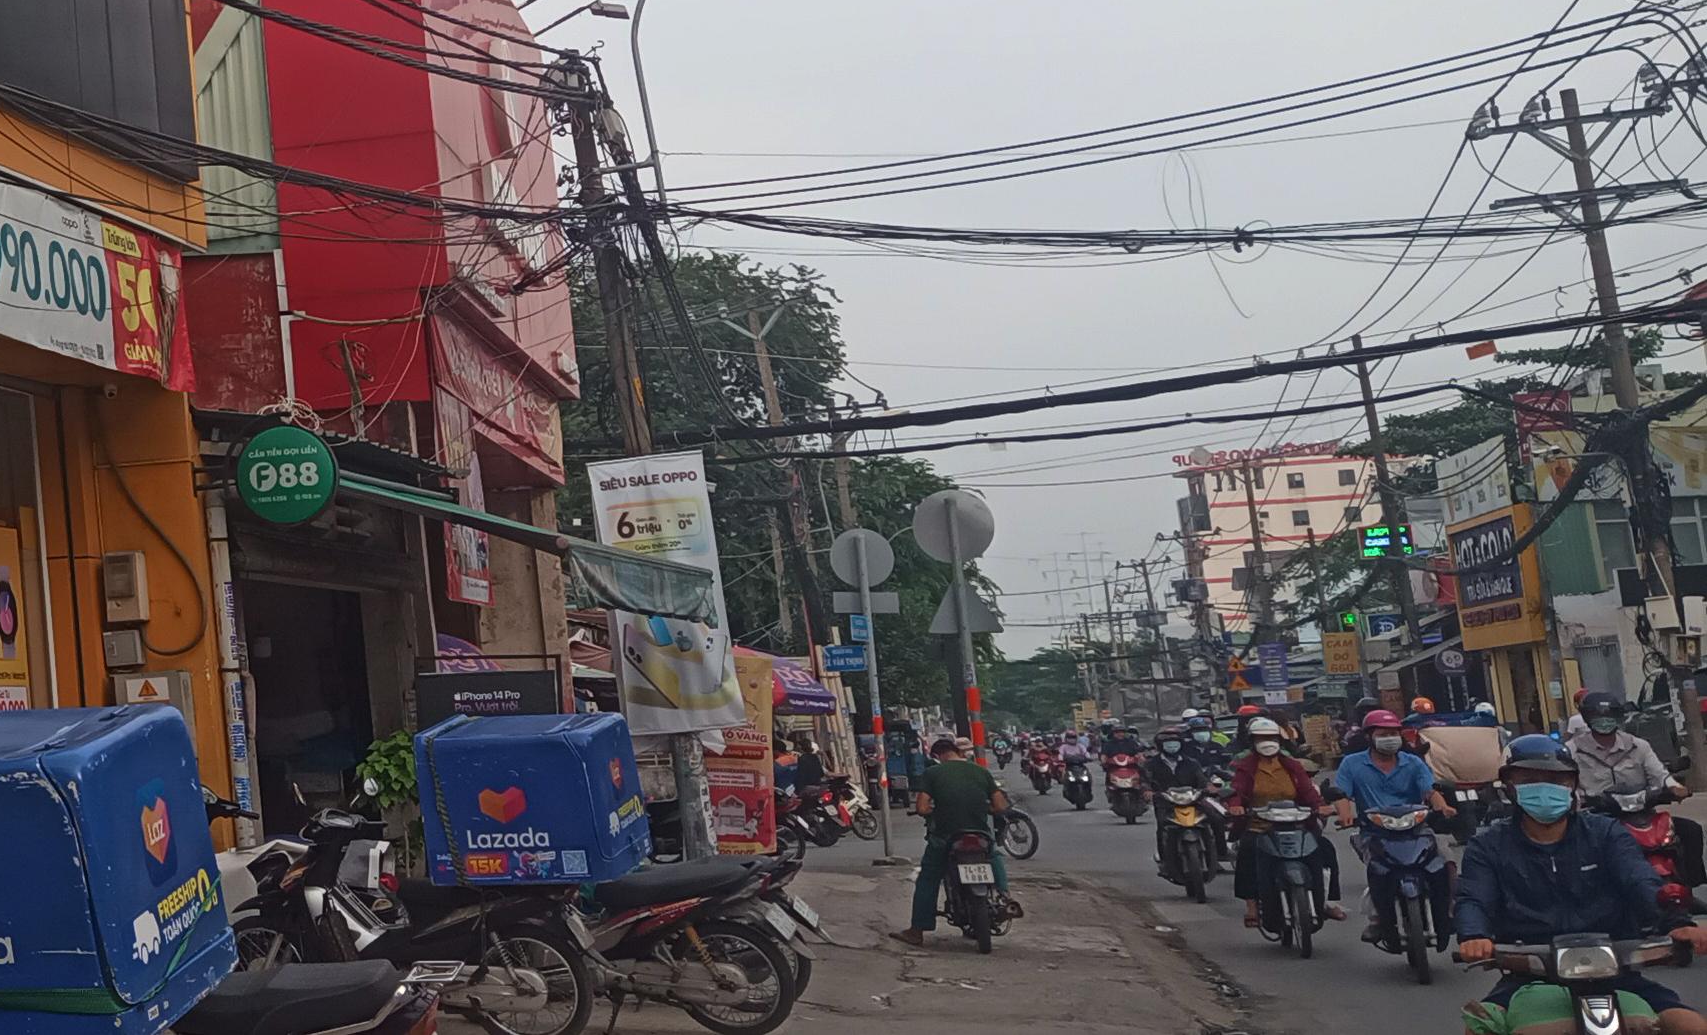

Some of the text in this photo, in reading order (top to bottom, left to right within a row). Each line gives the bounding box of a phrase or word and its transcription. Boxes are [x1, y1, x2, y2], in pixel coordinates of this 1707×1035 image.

[249, 461, 320, 492] F88
[599, 470, 698, 492] SIÊU SALE OPPO
[616, 510, 662, 539] 6 triệu
[461, 689, 521, 701] iPhone 14 Pro
[147, 818, 167, 845] Laz
[466, 826, 550, 849] Lazada
[469, 858, 504, 875] 15K
[157, 876, 197, 924] FREESHIP
